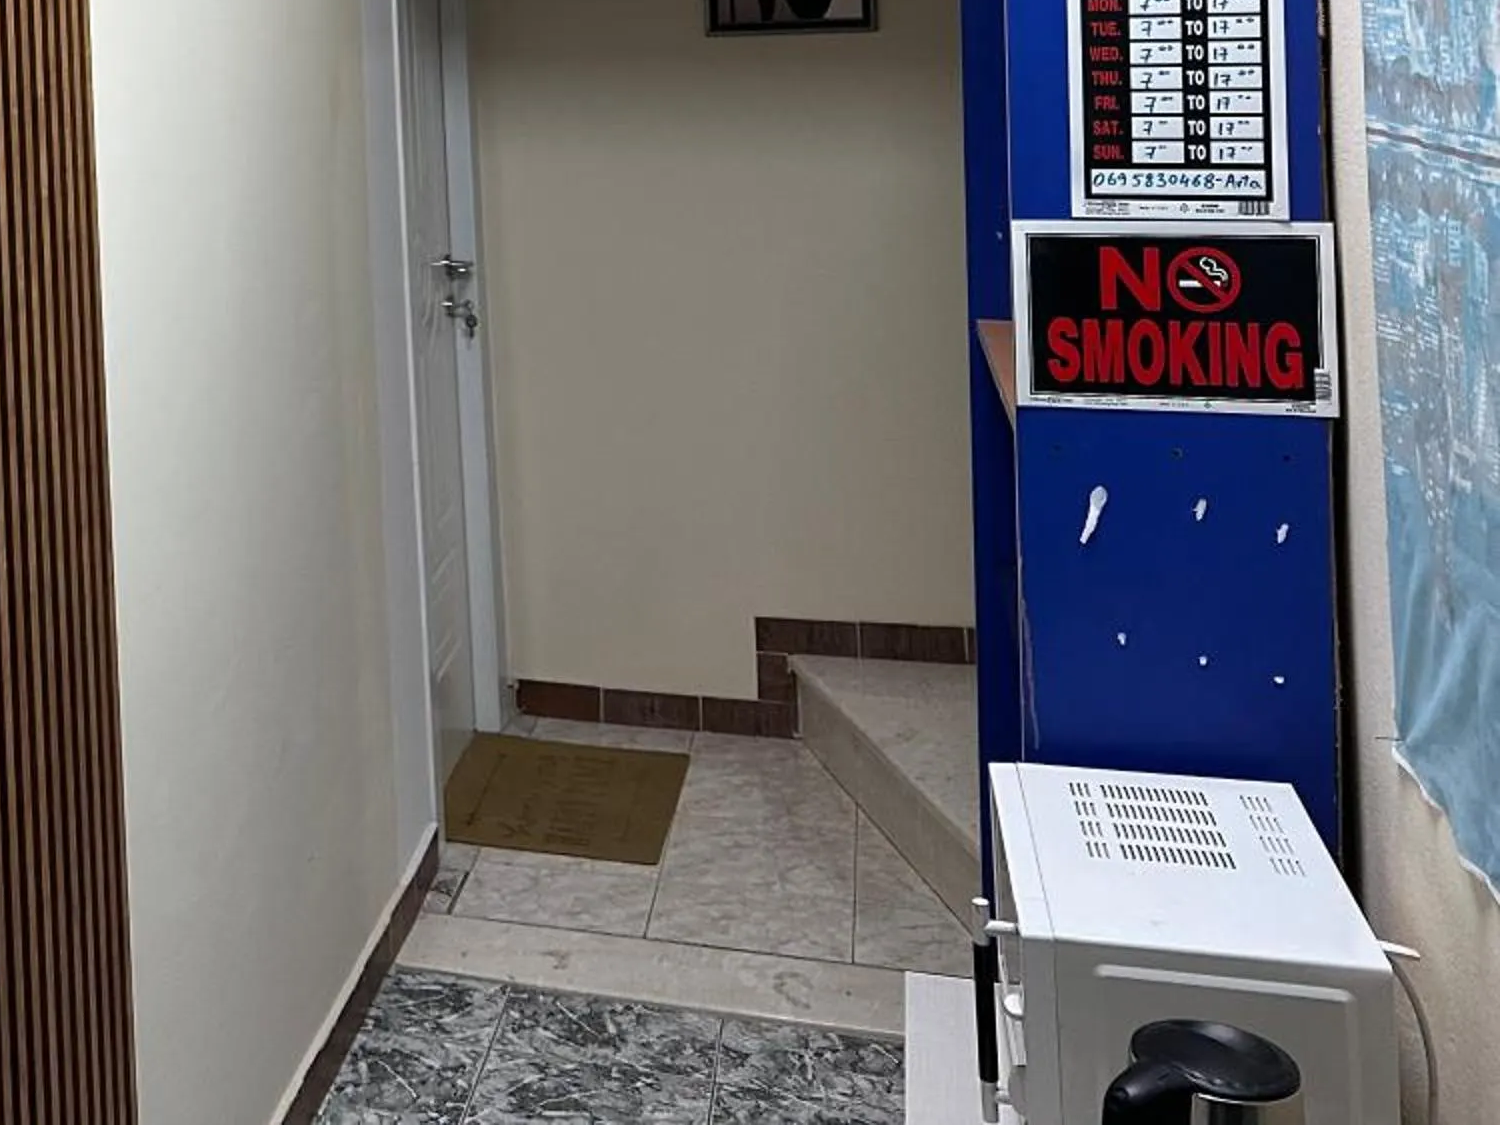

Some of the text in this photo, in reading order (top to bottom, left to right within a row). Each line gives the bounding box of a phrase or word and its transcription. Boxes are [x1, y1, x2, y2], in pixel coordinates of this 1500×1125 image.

[1091, 22, 1122, 37] TUE.
[1185, 20, 1204, 35] TO
[1090, 47, 1124, 62] WED.
[1185, 45, 1204, 60] TO
[1092, 72, 1123, 87] THU.
[1186, 71, 1205, 86] TO
[1094, 96, 1121, 111] FRI.
[1187, 95, 1205, 110] TO
[1093, 121, 1124, 136] SAT.
[1188, 120, 1206, 135] TO
[1093, 145, 1125, 160] SUN.
[1188, 145, 1207, 160] TO
[1047, 317, 1305, 390] SMOKING
